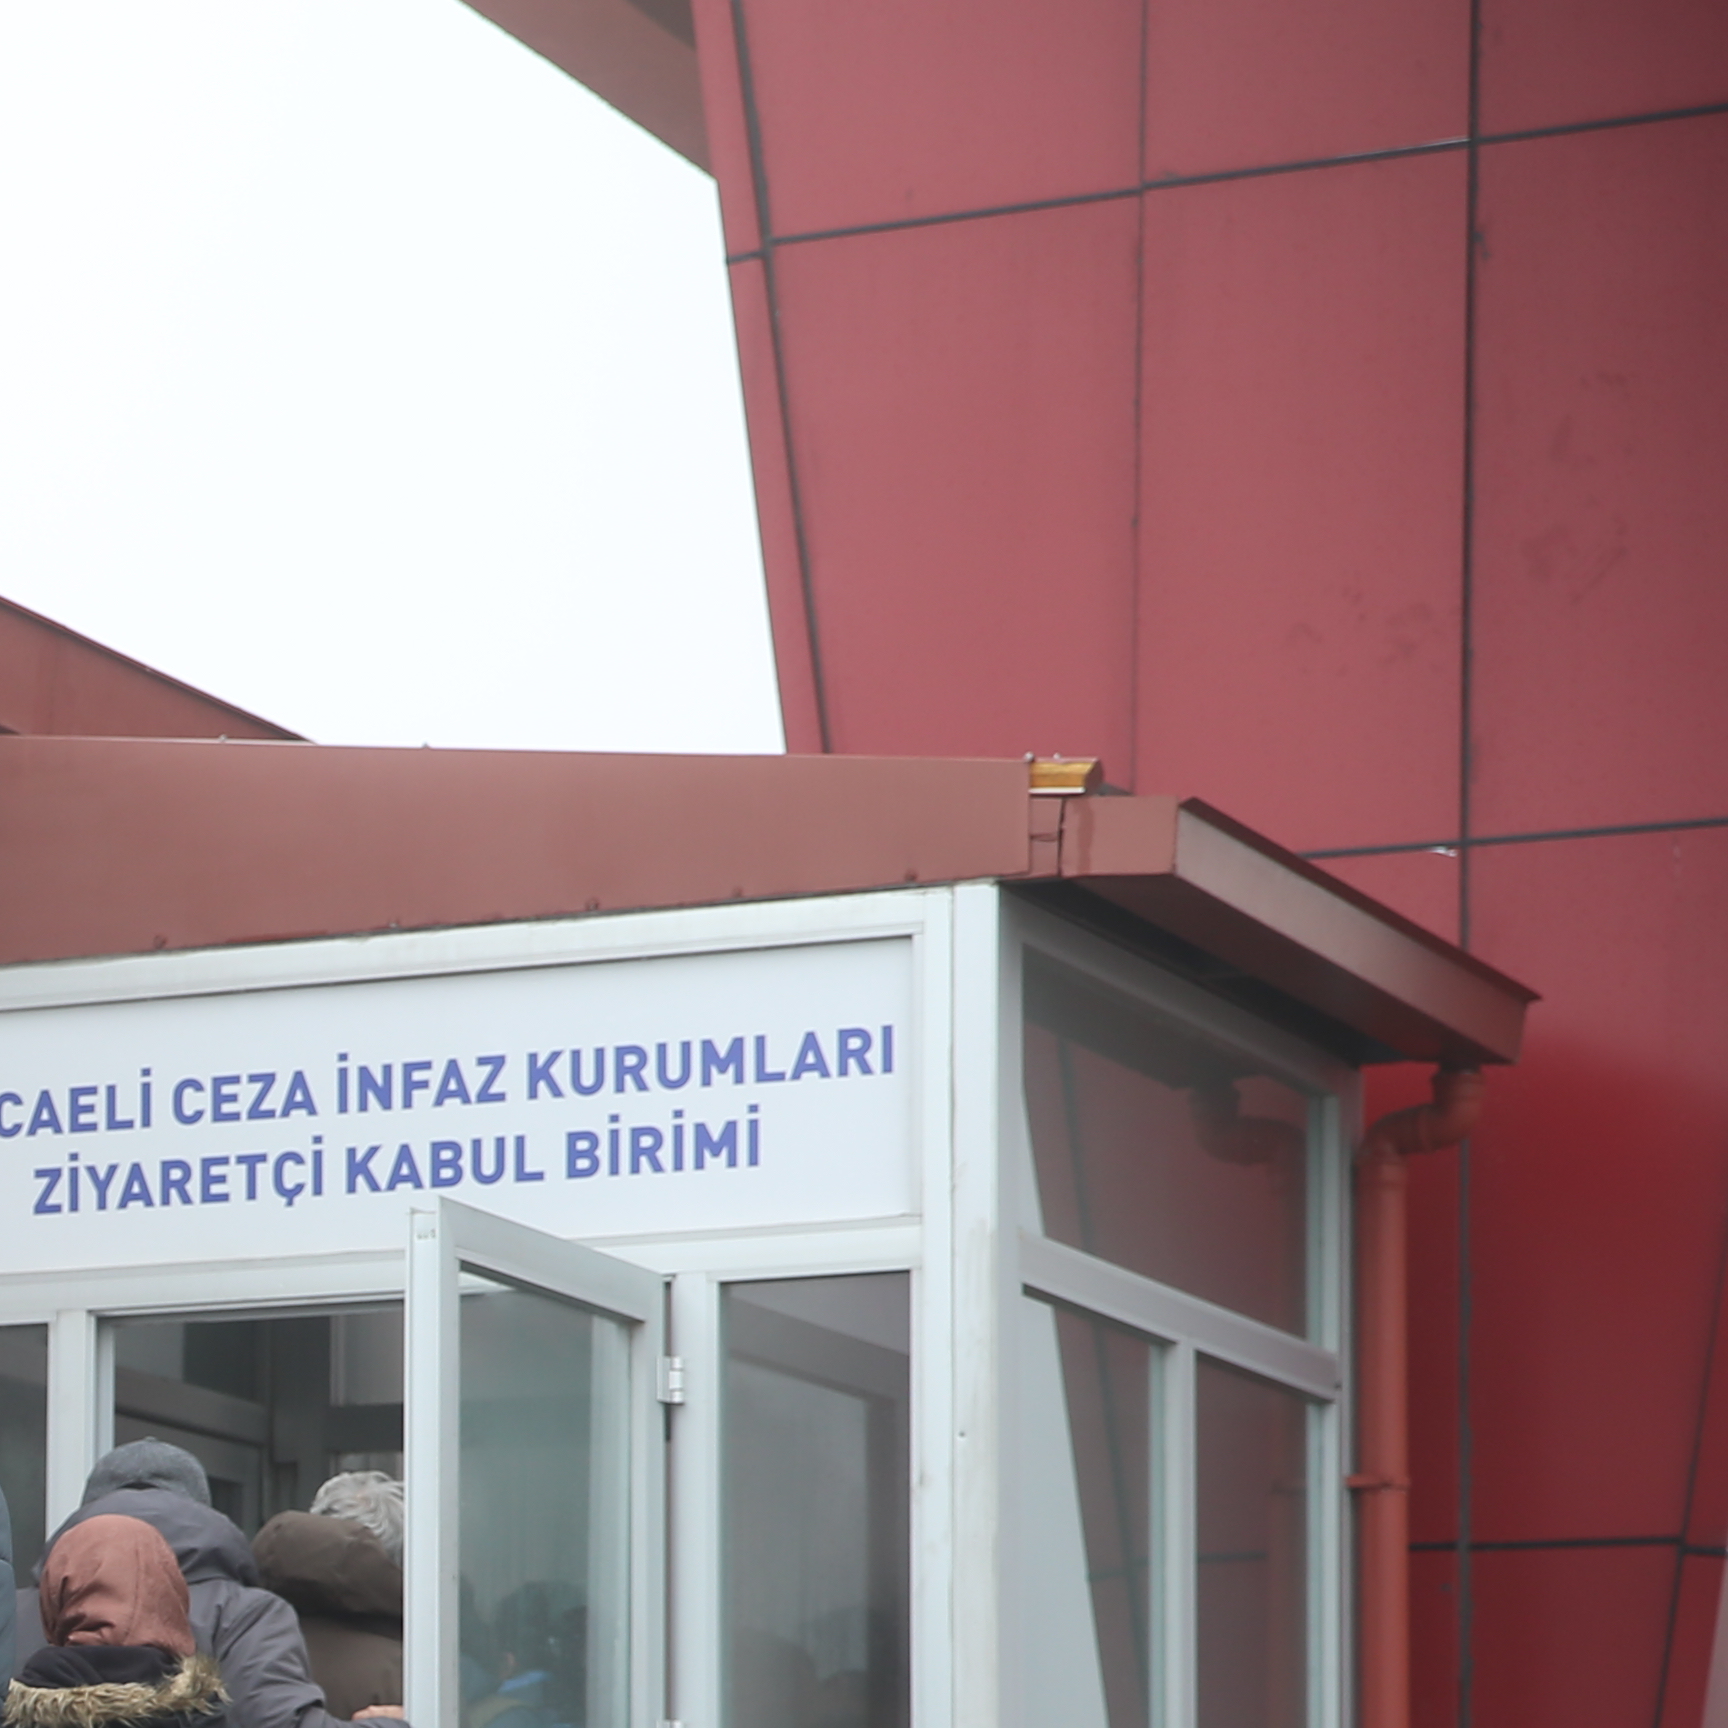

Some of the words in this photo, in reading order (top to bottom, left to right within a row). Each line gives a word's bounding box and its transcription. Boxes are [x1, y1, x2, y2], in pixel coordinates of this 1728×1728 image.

[173, 1069, 318, 1126] CEZA
[336, 1051, 507, 1114] İNFAZ
[527, 1024, 894, 1100] KURUMLARI
[33, 1134, 324, 1215] ZİYARETÇİ
[345, 1135, 546, 1195] KABUL
[565, 1104, 761, 1180] BİRİMİ
